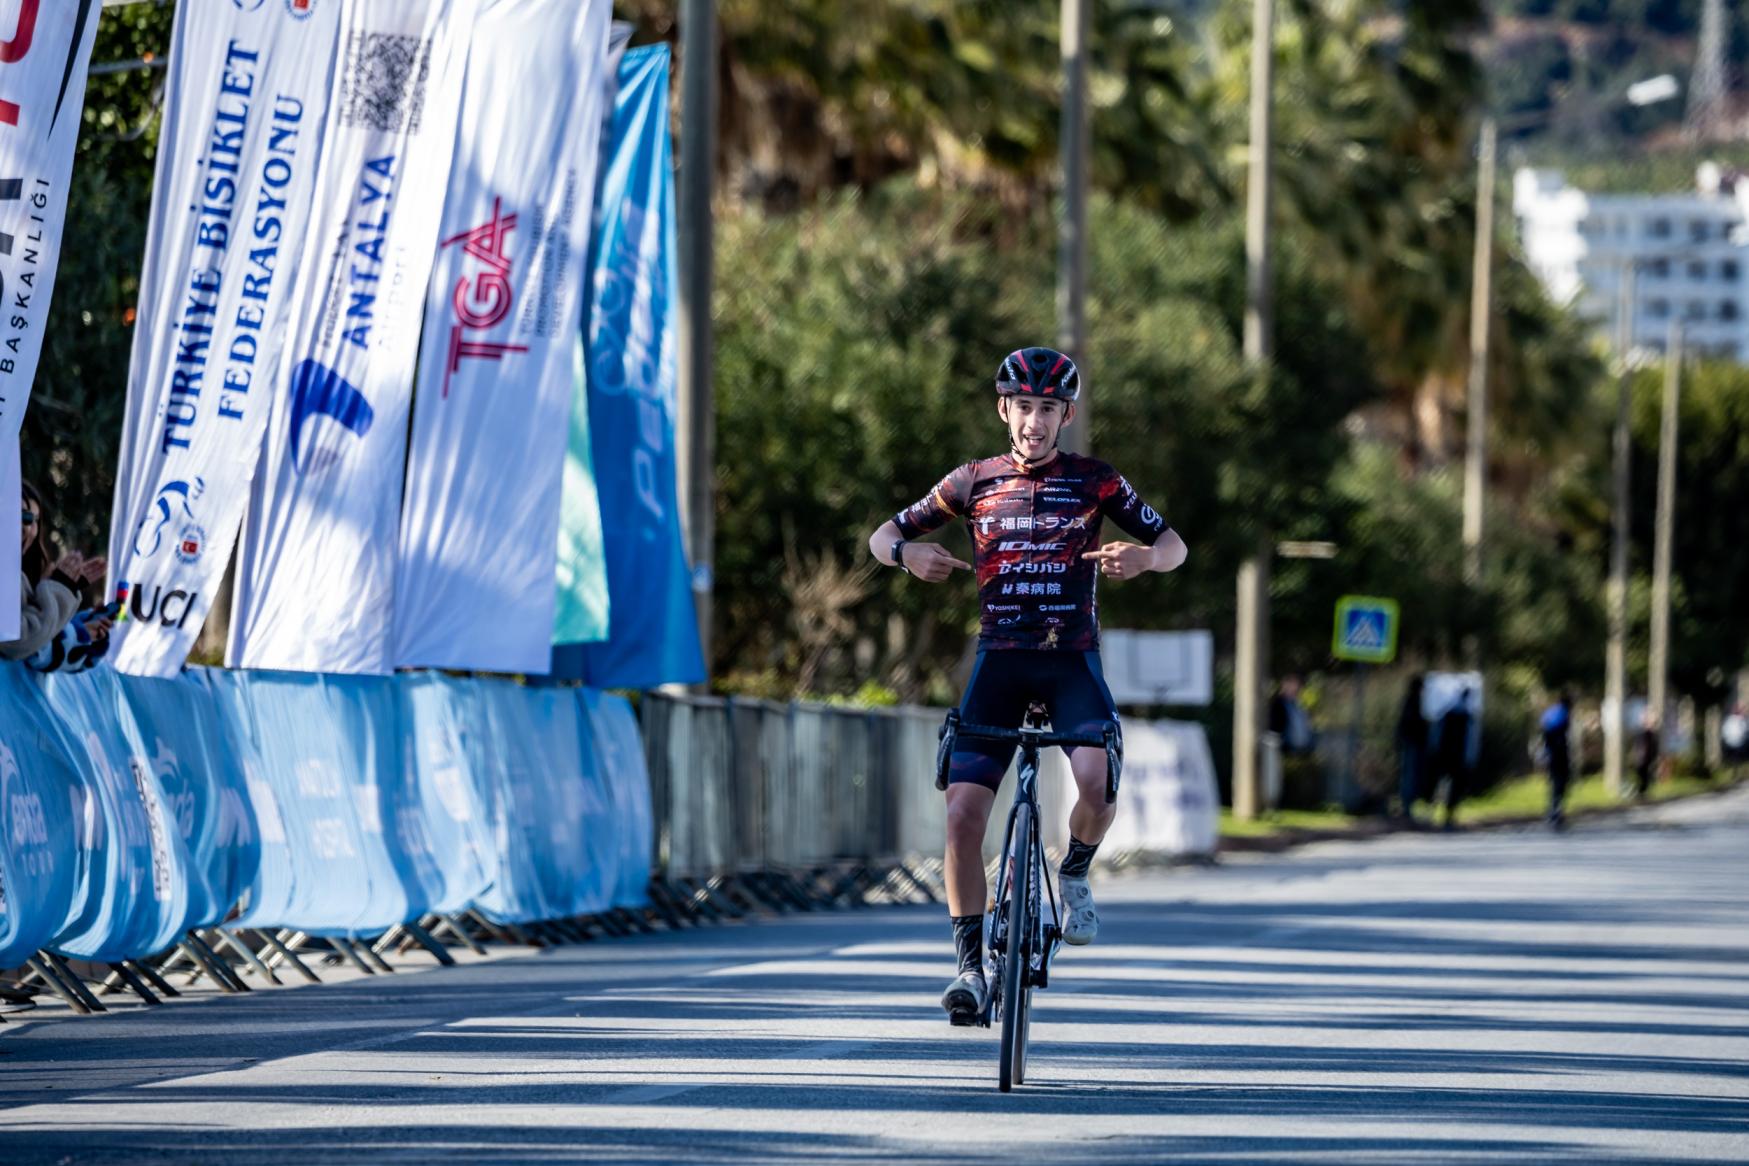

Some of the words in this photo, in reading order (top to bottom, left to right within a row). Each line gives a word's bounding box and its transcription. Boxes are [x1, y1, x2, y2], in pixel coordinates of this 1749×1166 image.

[0, 178, 50, 374] BAŞKANLIĞI
[158, 267, 221, 454] TÜRKİYE
[190, 40, 259, 251] BİSİKLET
[217, 94, 304, 421] FEDERASYONU
[342, 155, 396, 350] ANTALYA
[130, 583, 198, 630] UCI
[1000, 517, 1086, 530] 福岡トランス
